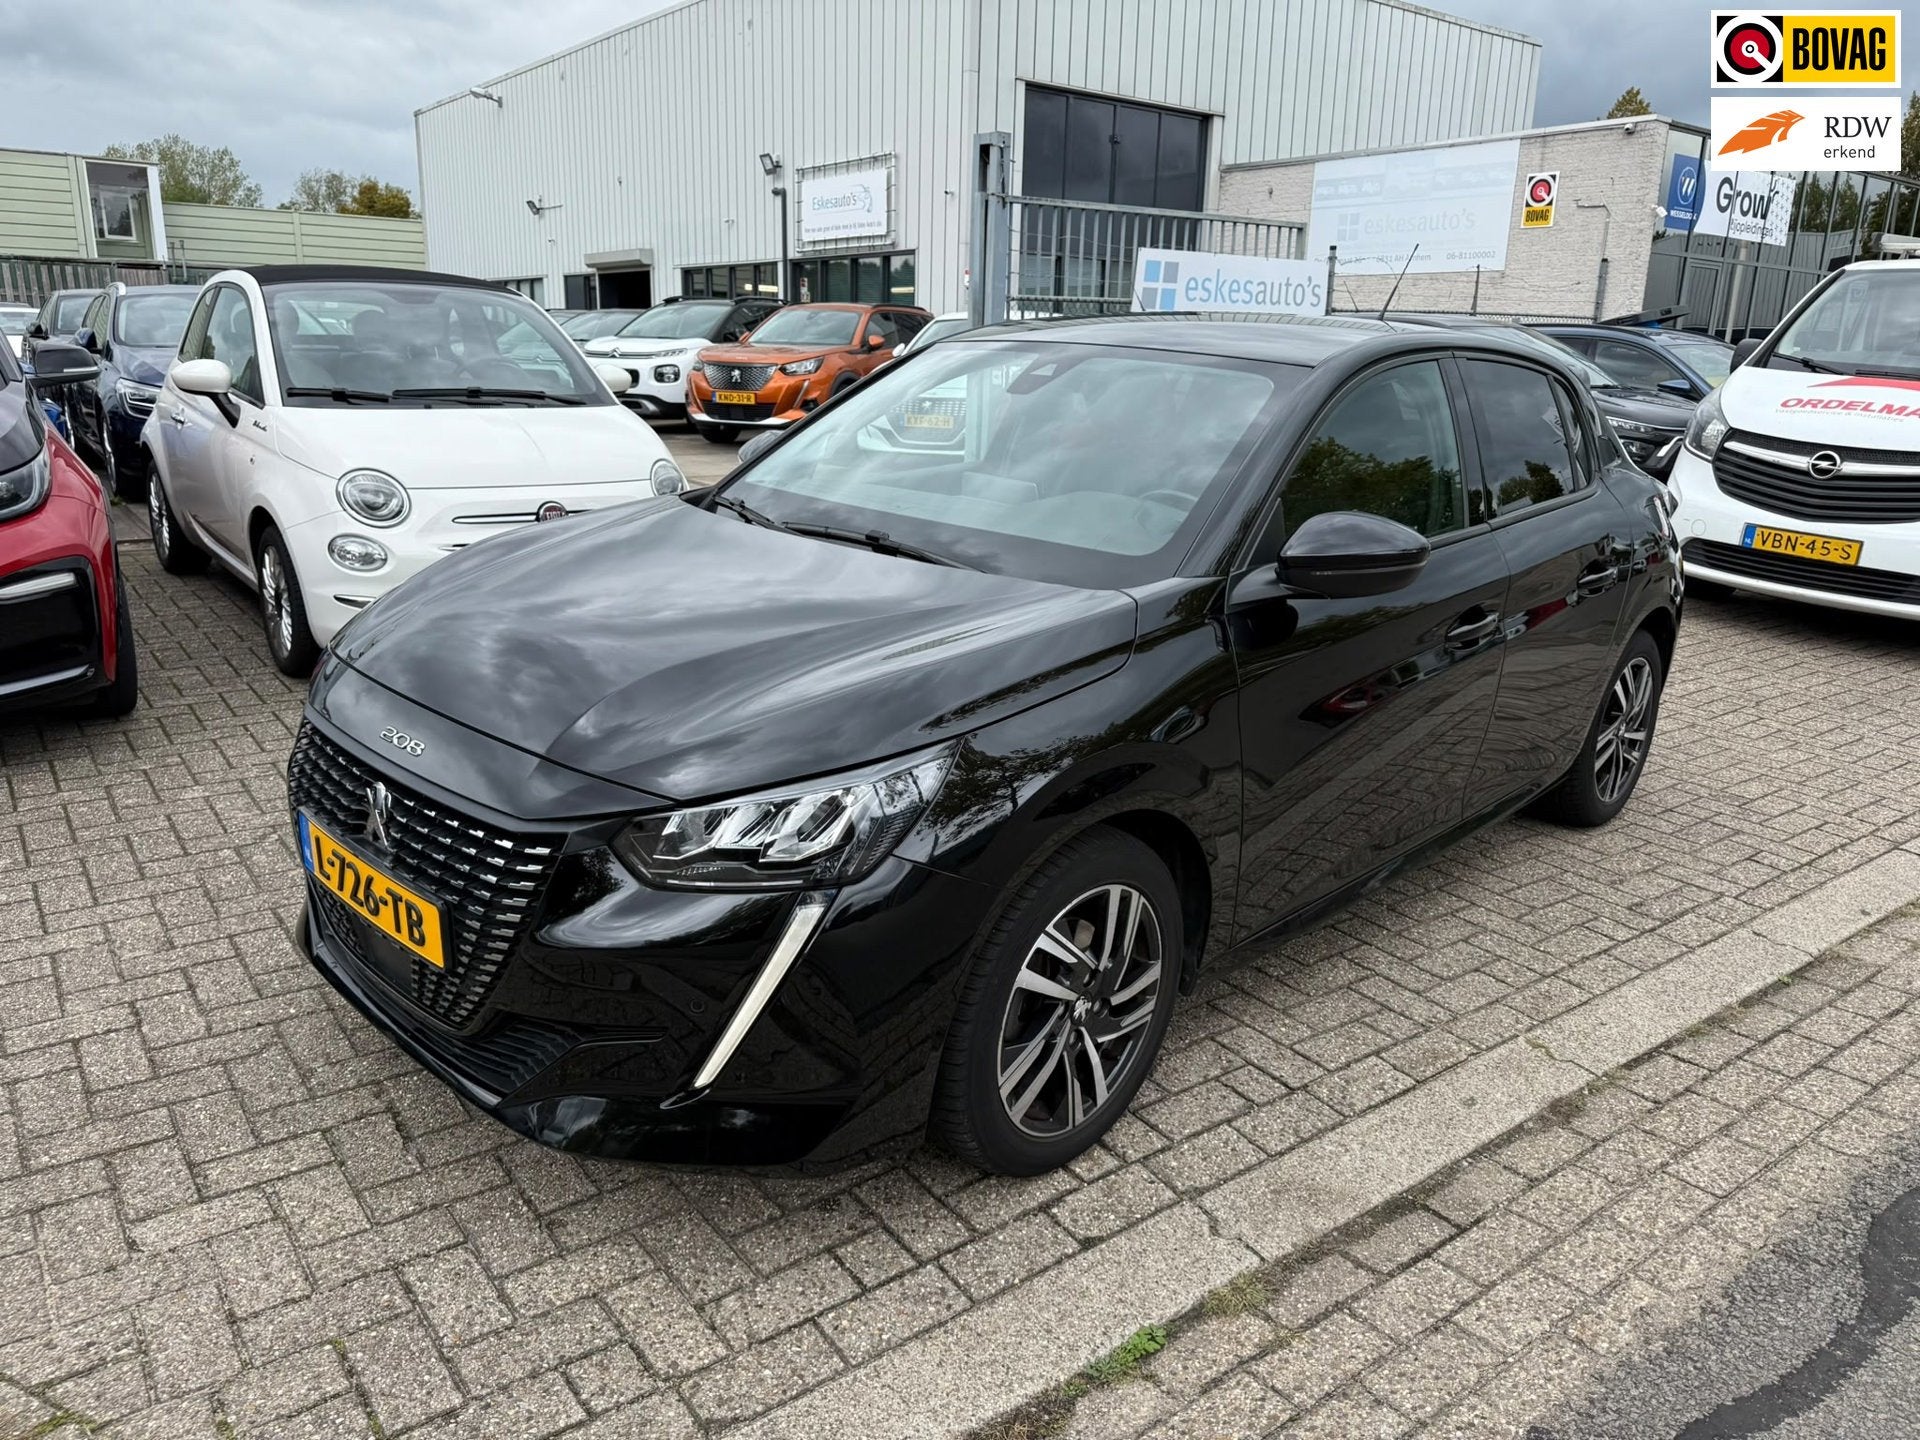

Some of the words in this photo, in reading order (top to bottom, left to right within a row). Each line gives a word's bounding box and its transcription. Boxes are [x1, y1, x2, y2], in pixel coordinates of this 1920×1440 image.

[812, 192, 857, 211] Eskesauto's
[1364, 208, 1477, 235] eskesauto's
[1525, 208, 1550, 223] BOVAG
[1404, 253, 1432, 262] Anhem
[1446, 250, 1496, 260] 06-81100002
[1185, 268, 1321, 307] eskesauto's
[718, 393, 752, 403] KND-31-R
[1758, 530, 1853, 560] VBN-45-S
[380, 726, 426, 757] 208
[315, 834, 426, 947] L-726-TB
